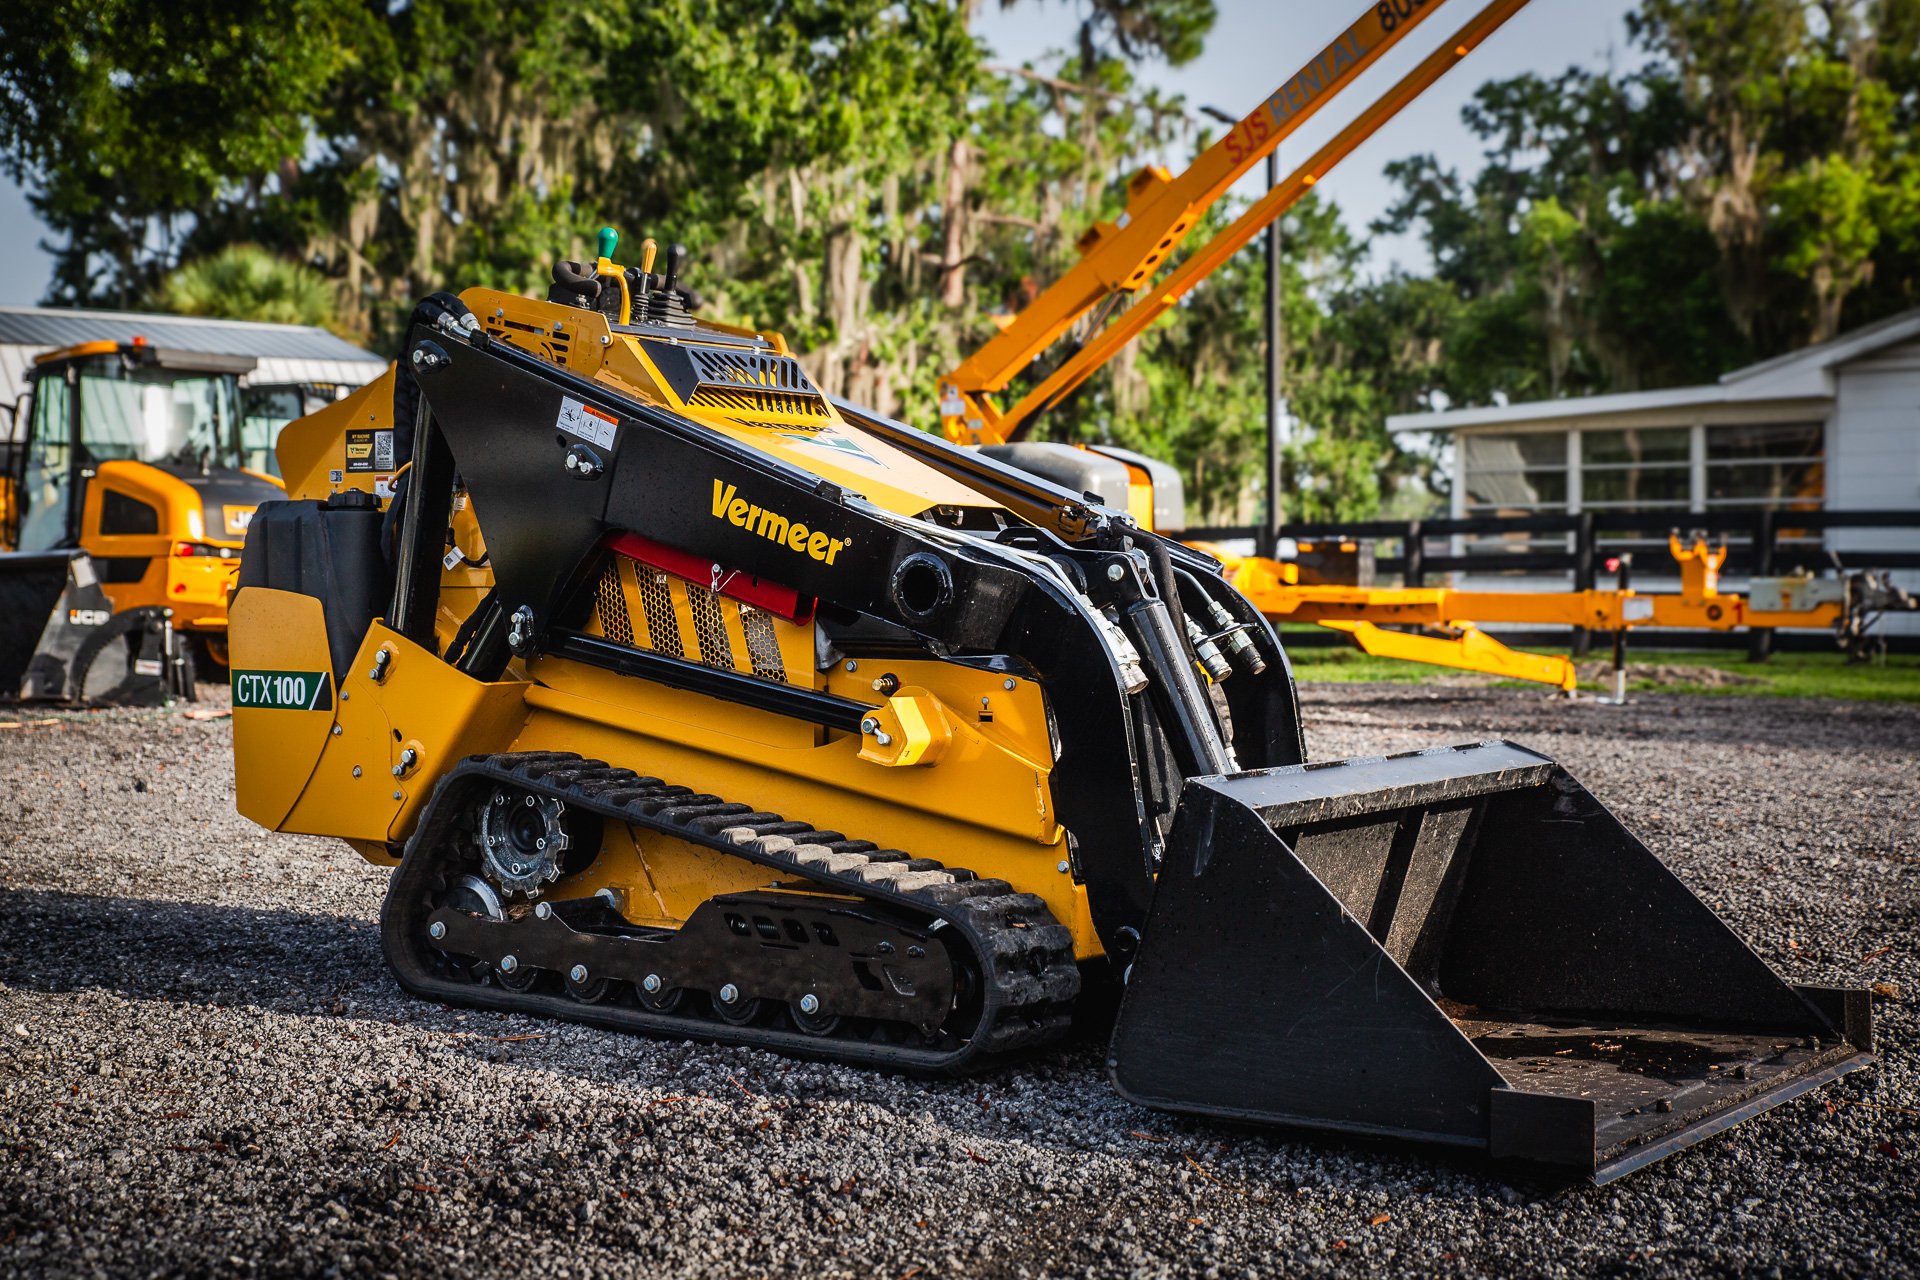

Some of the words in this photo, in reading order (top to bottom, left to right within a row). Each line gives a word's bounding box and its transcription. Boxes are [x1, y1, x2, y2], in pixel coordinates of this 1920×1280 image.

[1224, 111, 1268, 165] SJS
[1268, 30, 1368, 126] RENTAL
[1377, 0, 1427, 32] 80
[712, 478, 844, 566] Vermeer
[70, 609, 110, 626] JCB
